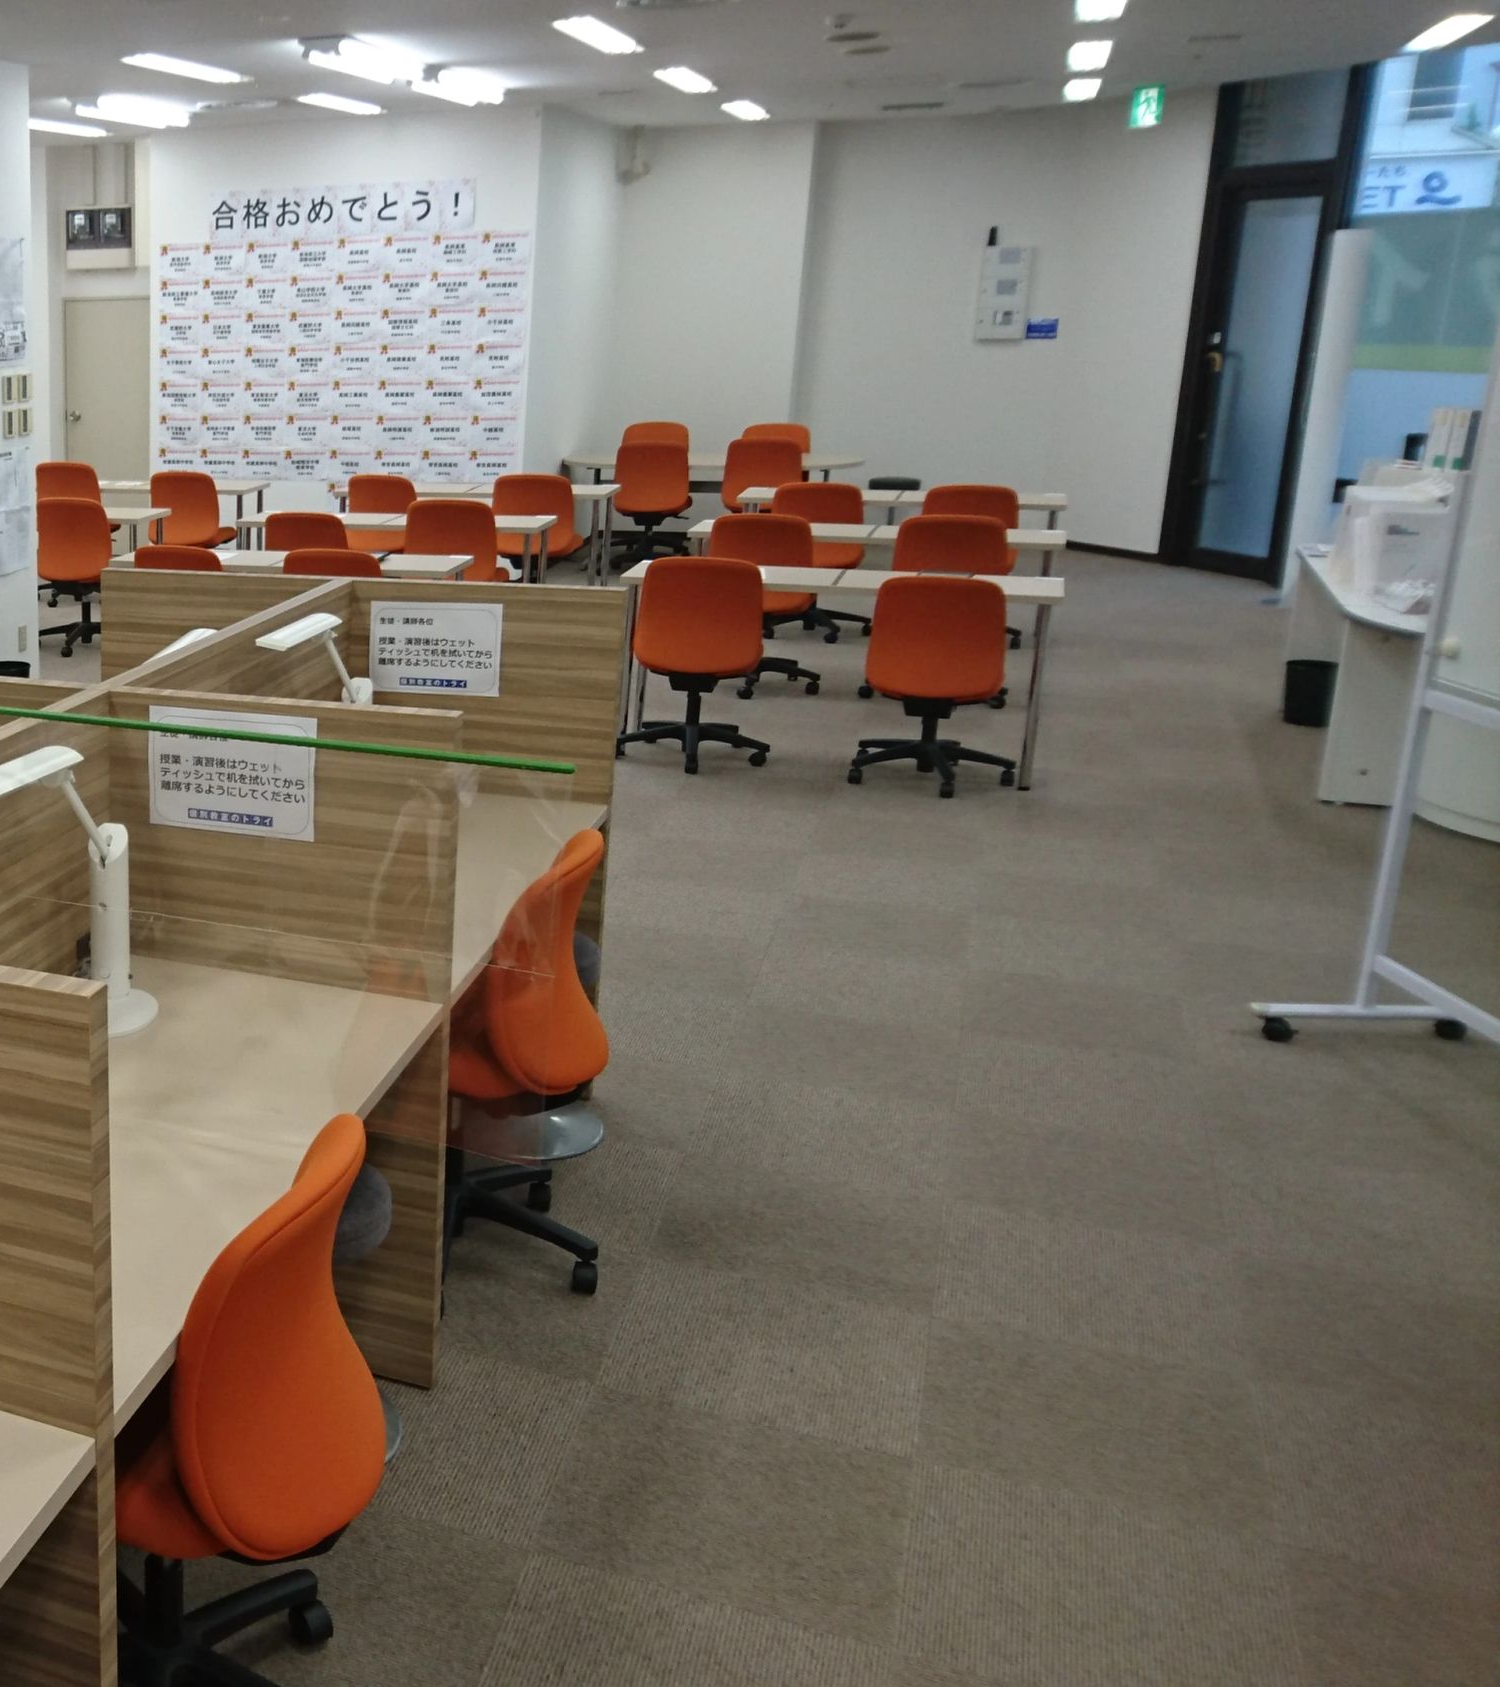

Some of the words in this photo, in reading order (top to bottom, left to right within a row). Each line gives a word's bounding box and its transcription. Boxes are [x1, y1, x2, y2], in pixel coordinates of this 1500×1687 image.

[160, 753, 283, 774] 授業・演習後はウェット
[160, 767, 305, 790] ティッシュで机を拭いてから
[161, 780, 305, 804] 離席するようにしてください
